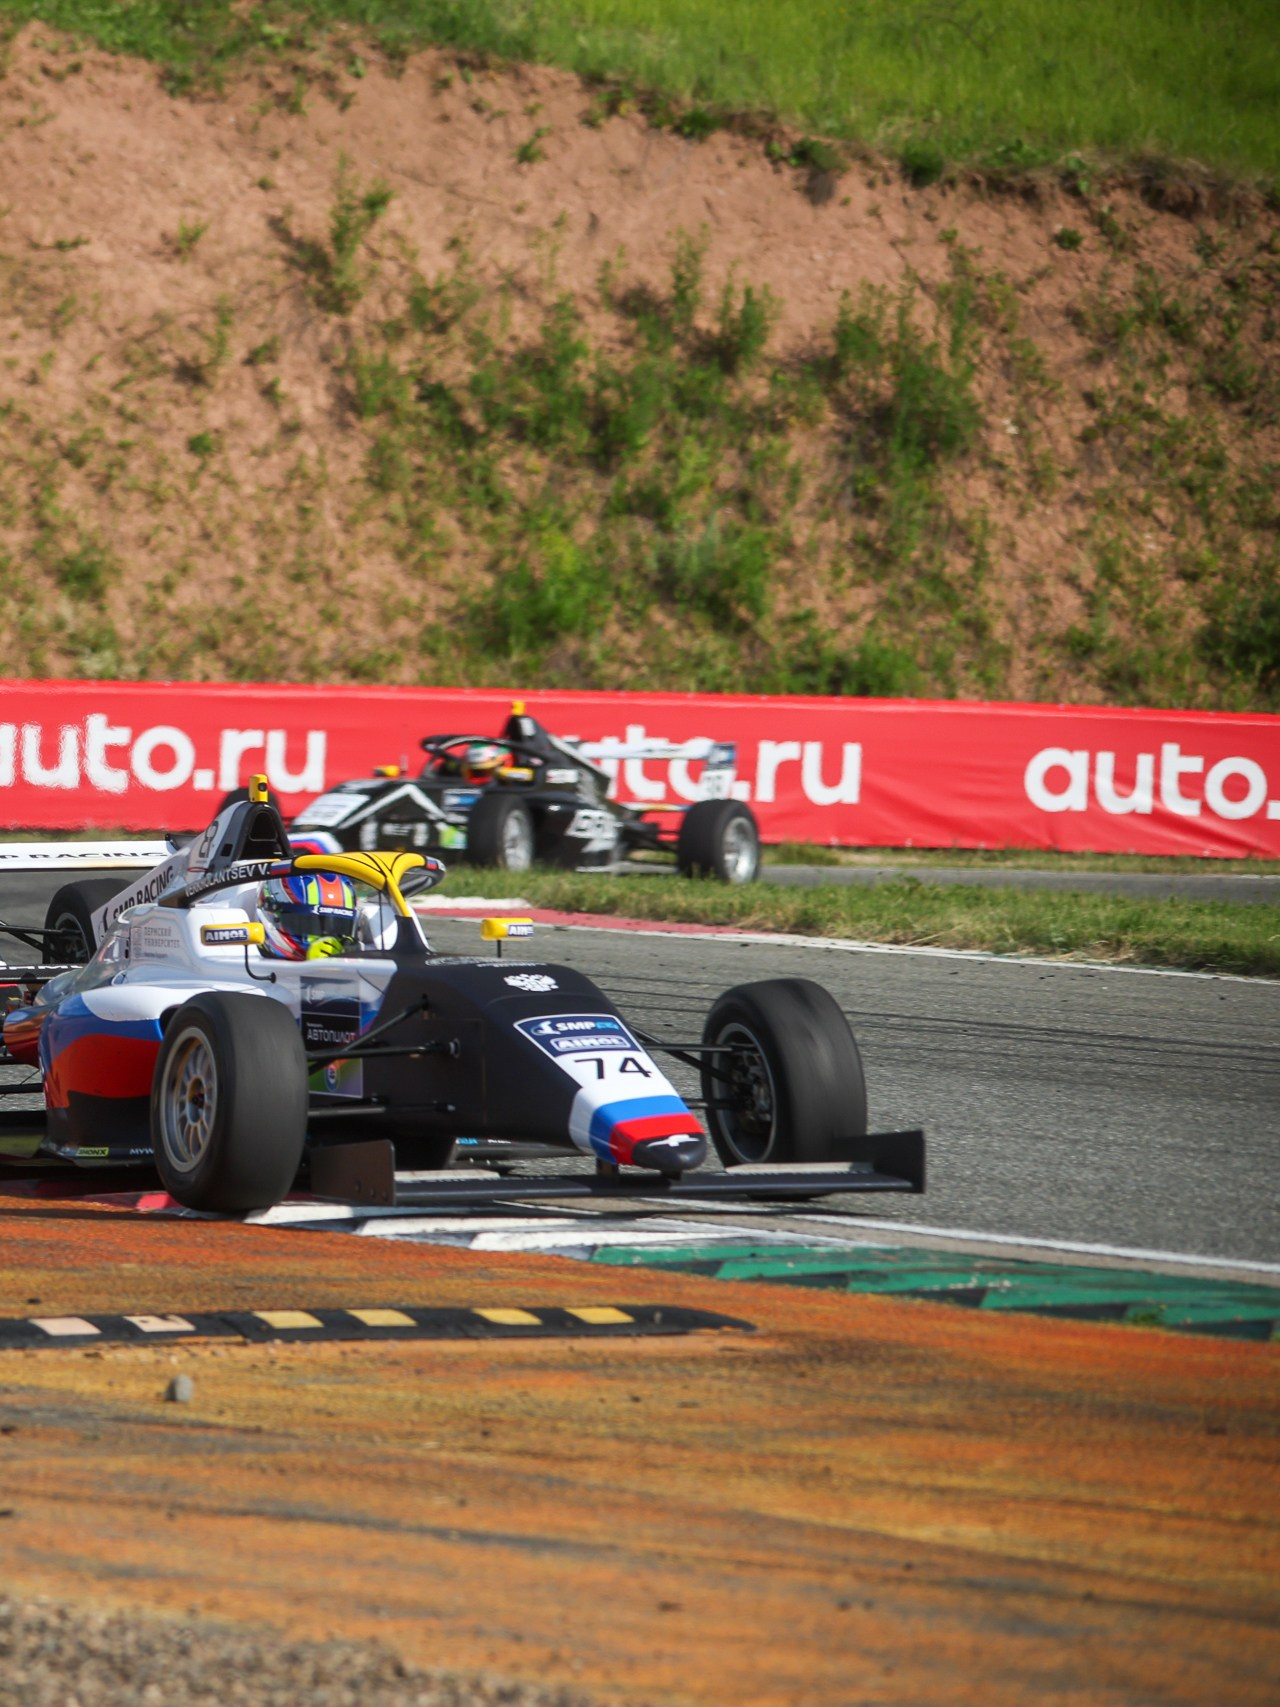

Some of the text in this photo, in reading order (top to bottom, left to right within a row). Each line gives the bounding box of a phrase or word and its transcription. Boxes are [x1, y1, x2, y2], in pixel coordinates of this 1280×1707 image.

[135, 865, 176, 907] RACING
[205, 928, 249, 942] AIMOL
[555, 1022, 595, 1031] SMP
[558, 1037, 624, 1049] AIMOL
[573, 1057, 652, 1080] 74
